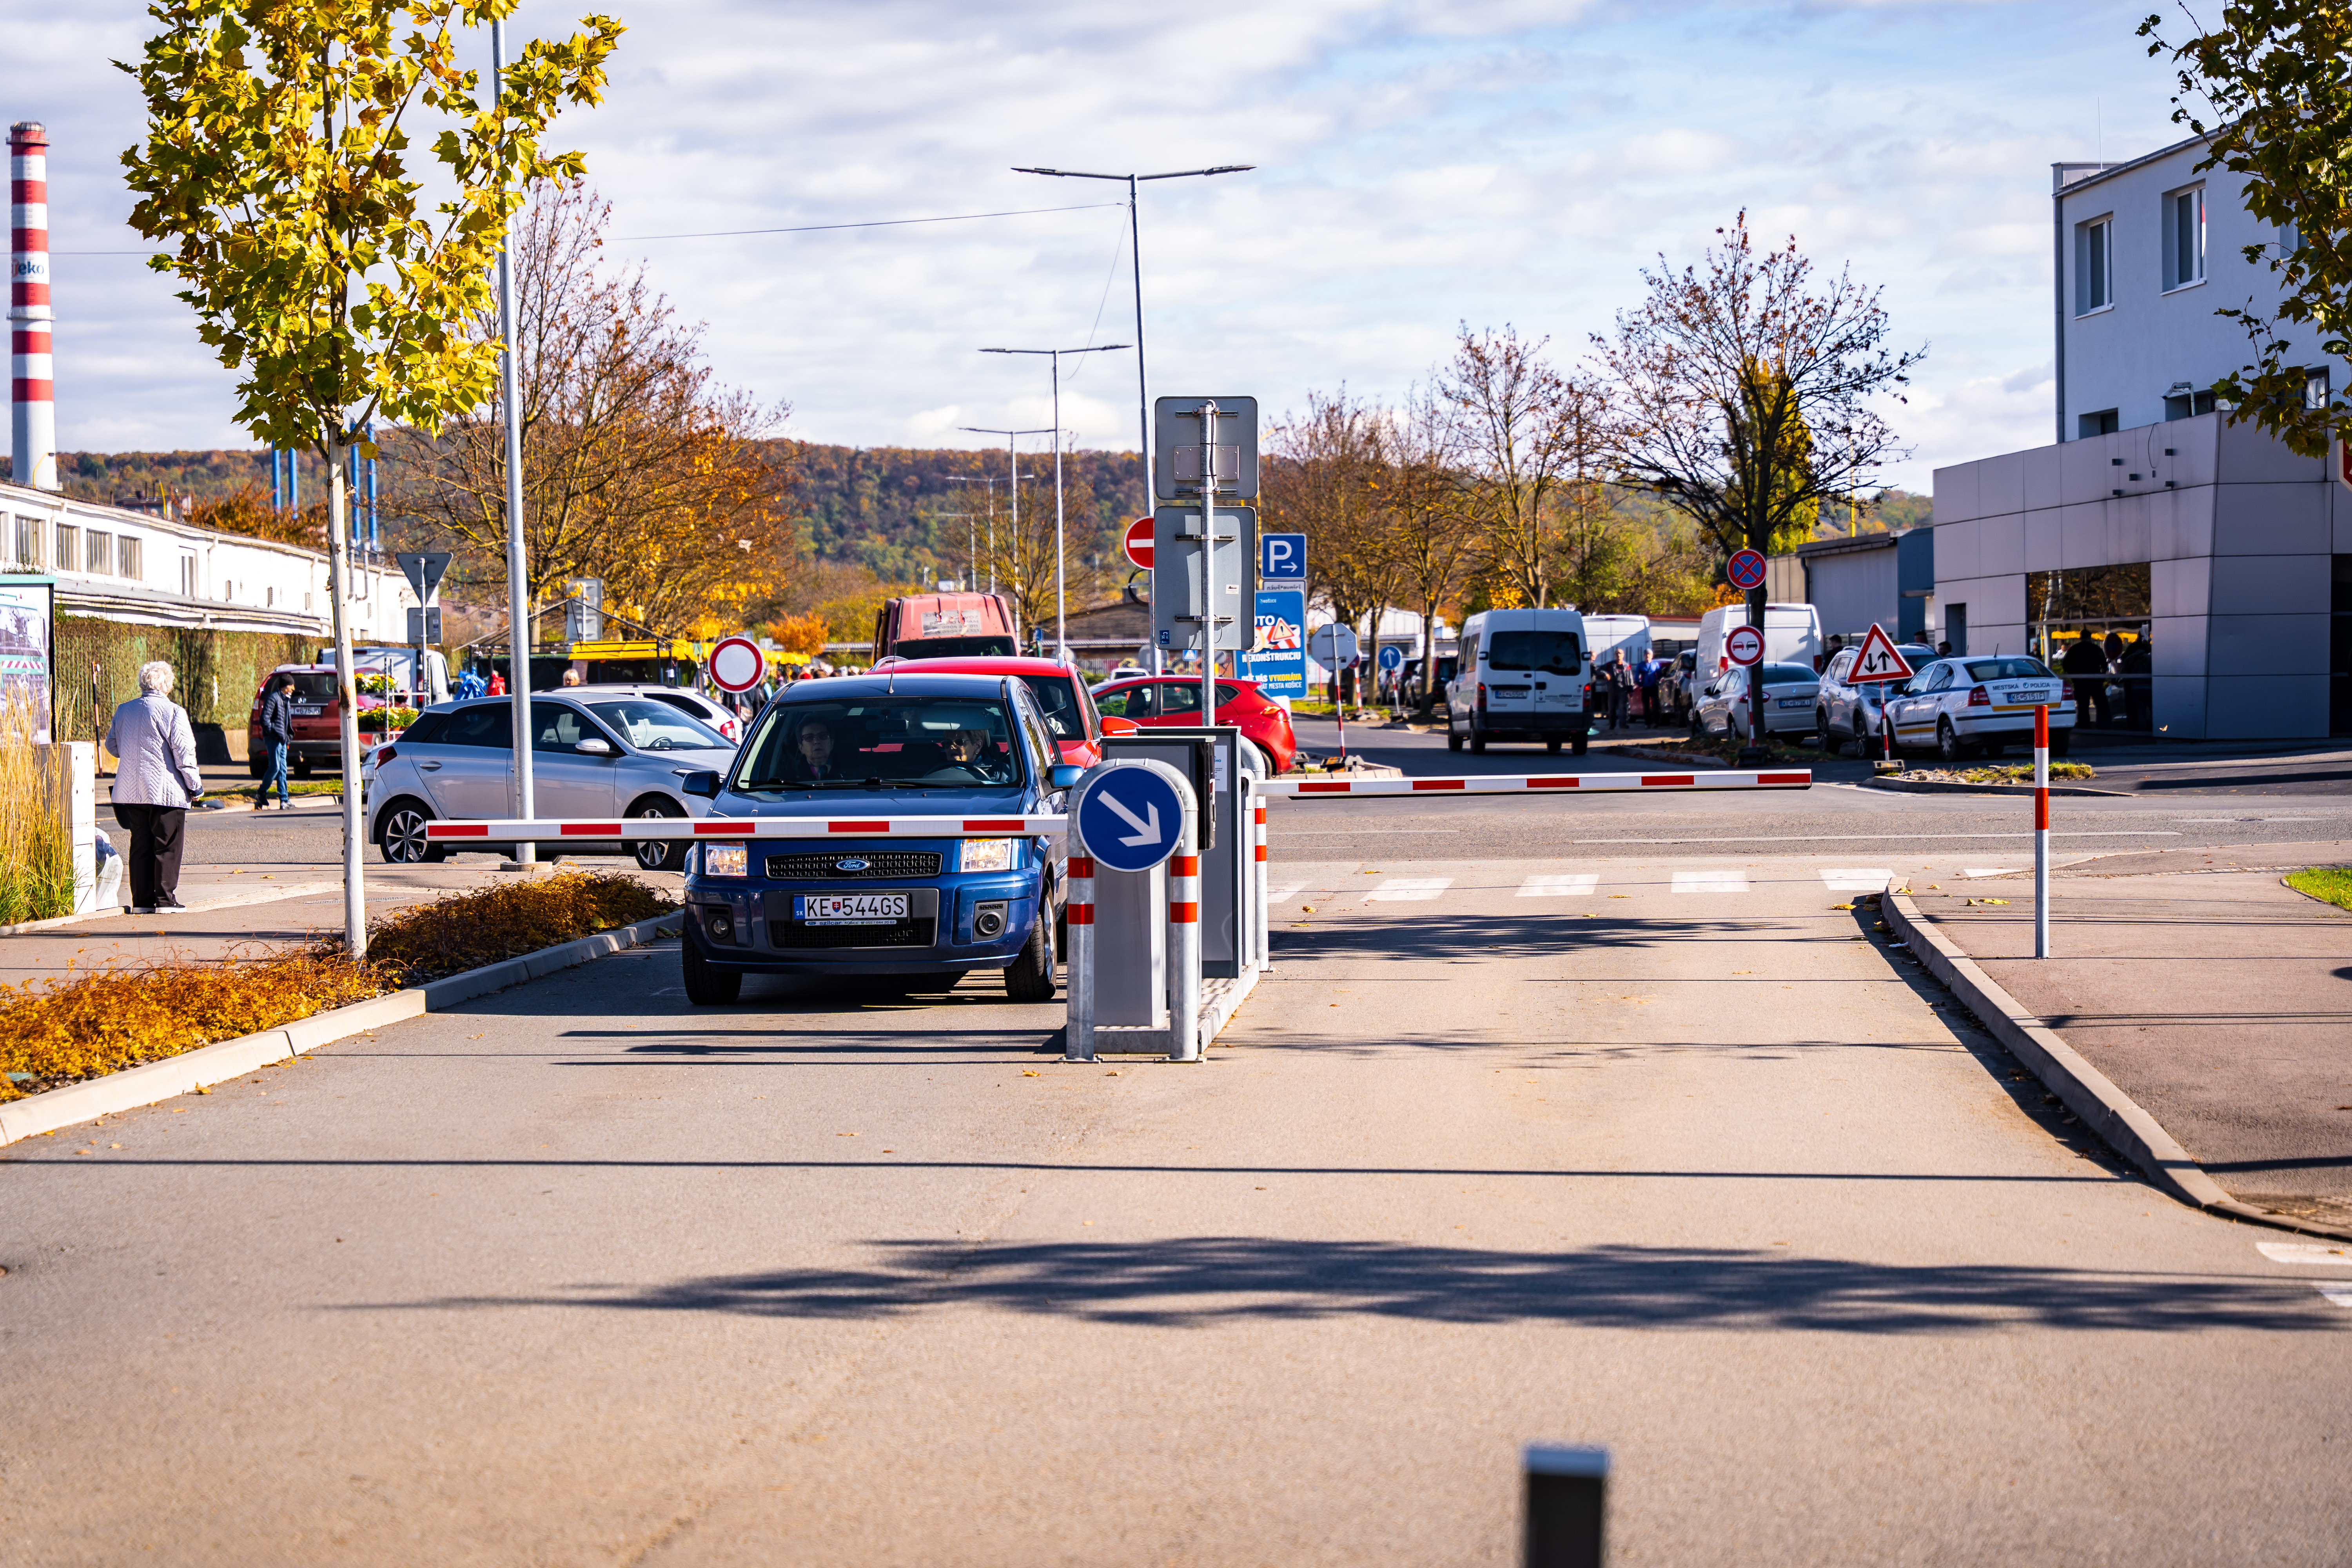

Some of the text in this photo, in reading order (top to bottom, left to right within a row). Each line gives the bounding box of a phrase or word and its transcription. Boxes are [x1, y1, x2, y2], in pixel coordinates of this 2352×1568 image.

[1269, 541, 1292, 572] P
[1242, 651, 1301, 662] REKONŠTRUKCIU
[1255, 674, 1268, 682] VÁS
[1269, 672, 1301, 682] VYKONÁVA
[807, 897, 904, 917] KE 544GS
